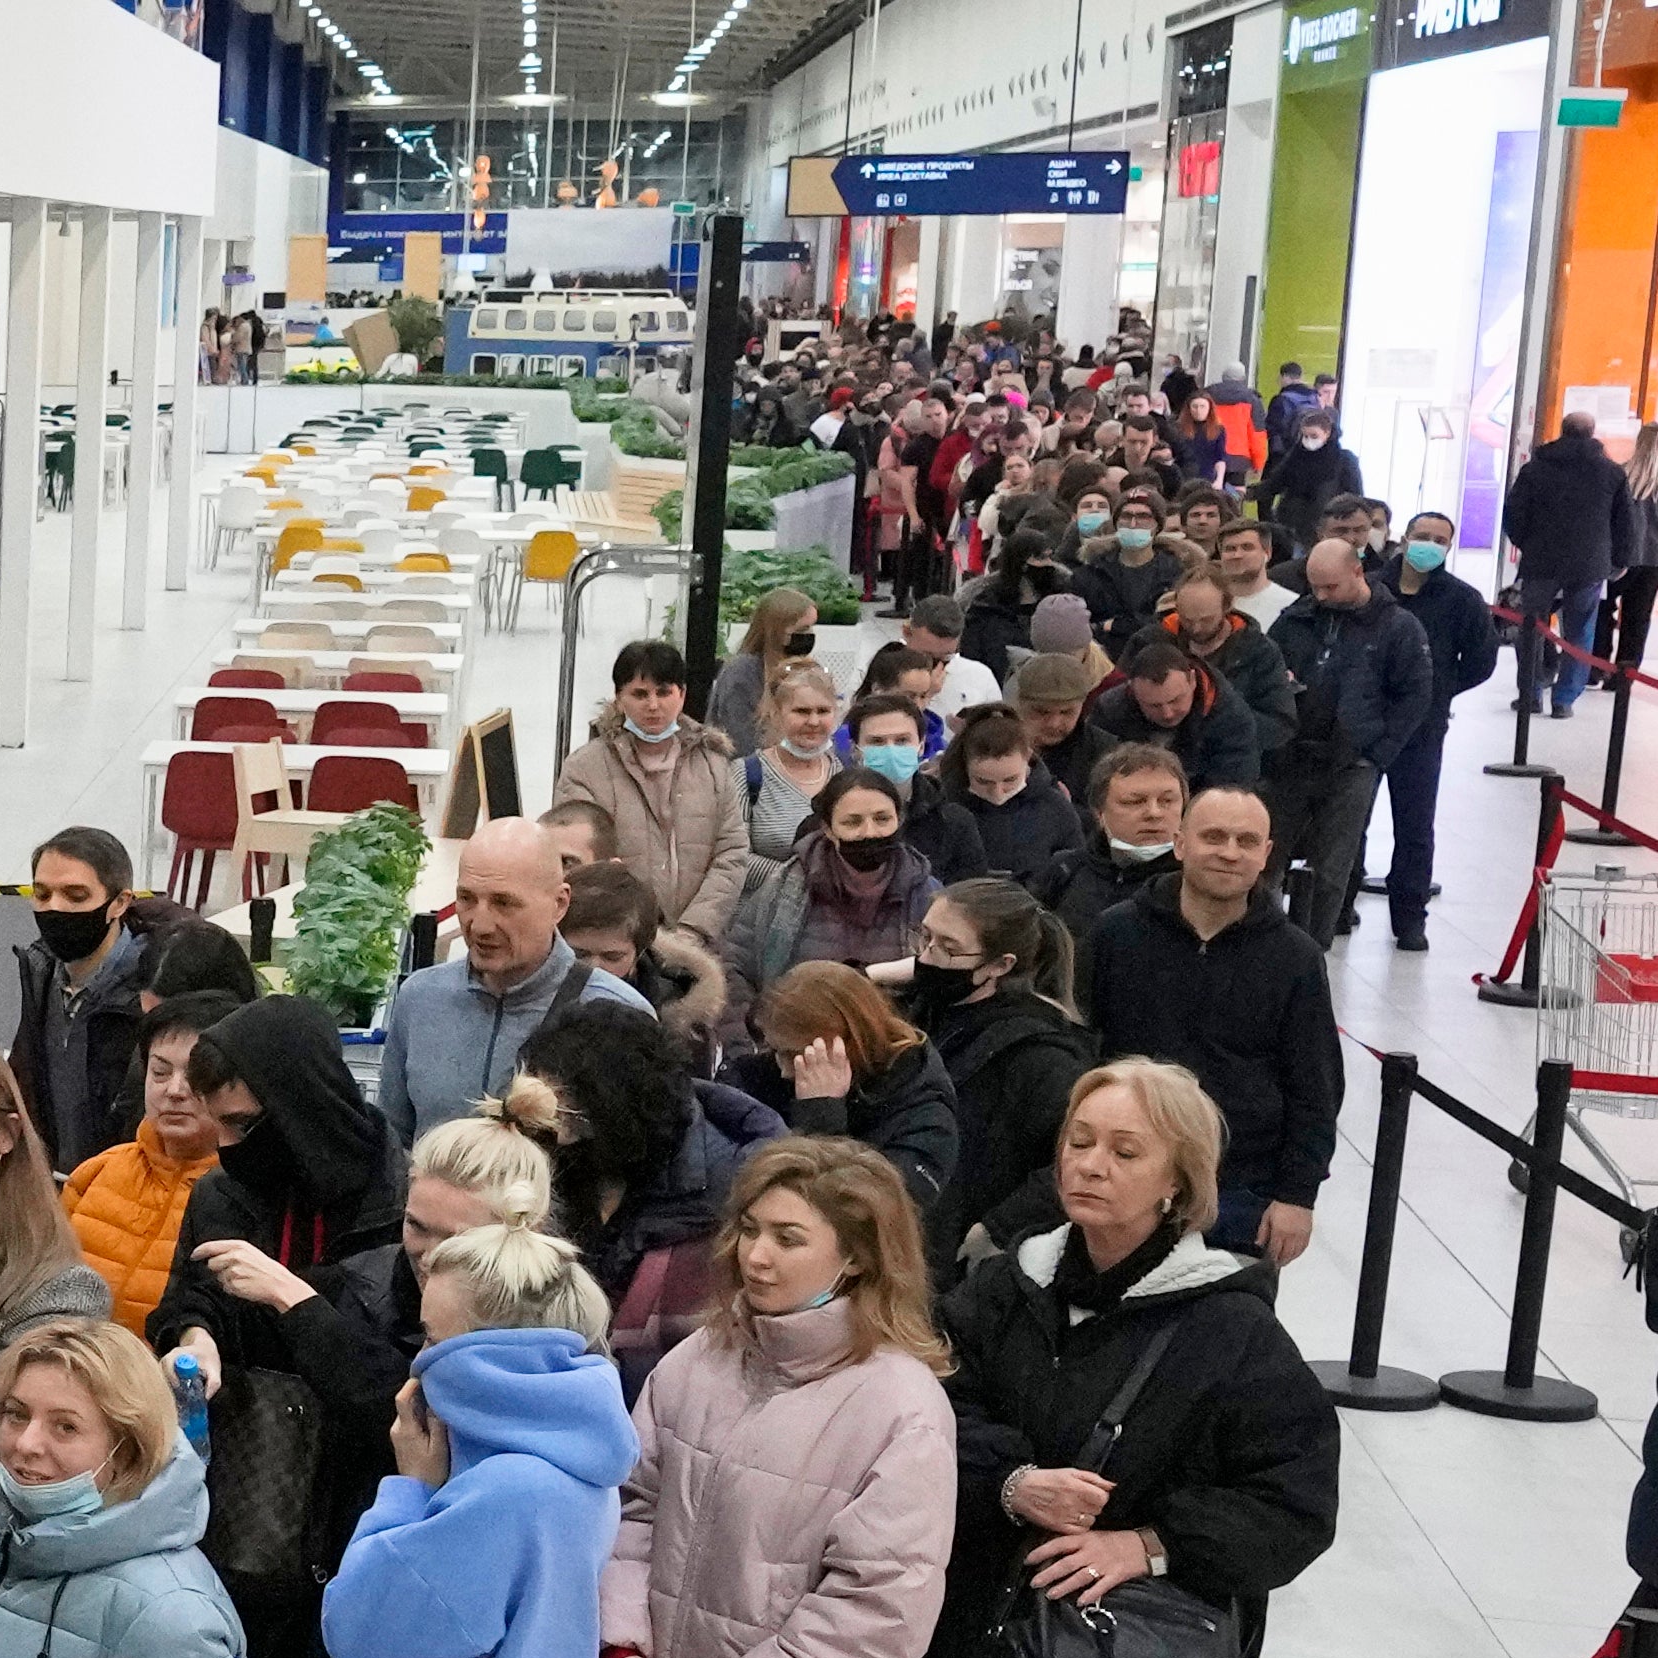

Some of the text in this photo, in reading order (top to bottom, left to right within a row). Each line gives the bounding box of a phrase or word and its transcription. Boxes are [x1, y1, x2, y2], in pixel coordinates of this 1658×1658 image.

[926, 161, 974, 170] ПРОДУКТЫ
[1048, 160, 1077, 168] АШАН
[901, 172, 948, 181] ДОСТАВКА
